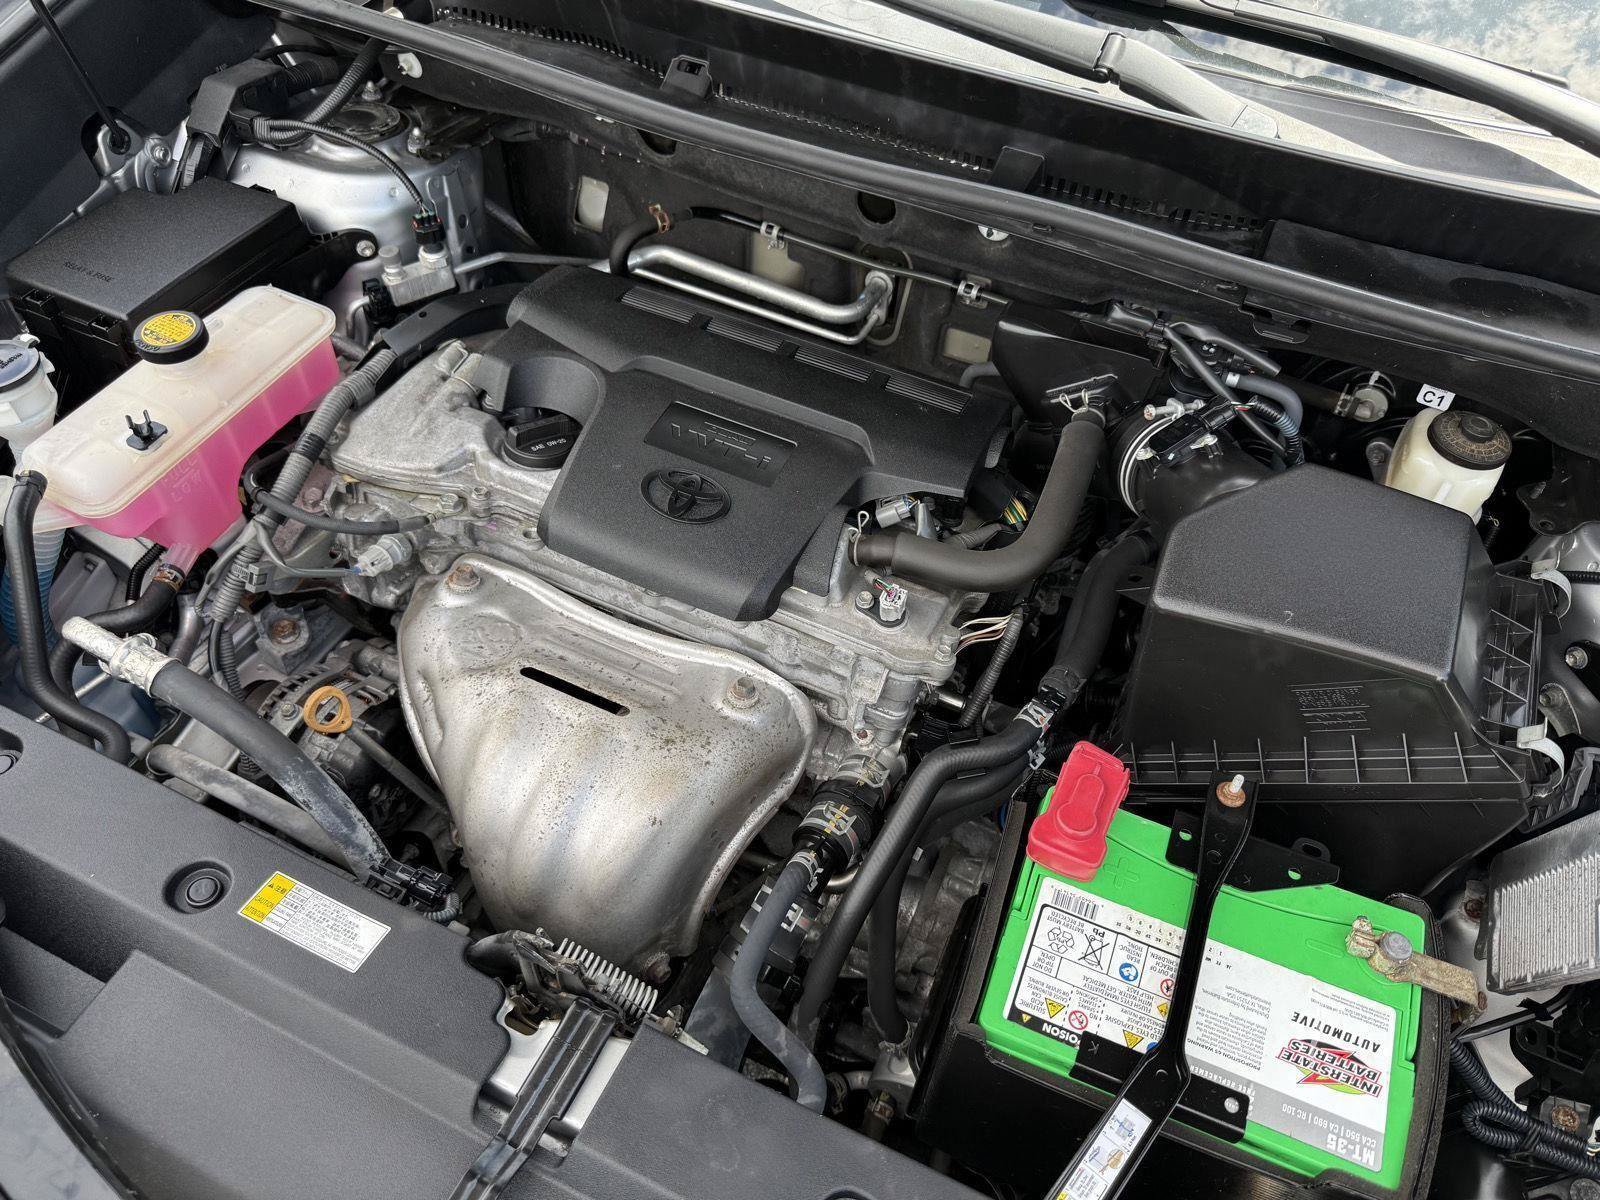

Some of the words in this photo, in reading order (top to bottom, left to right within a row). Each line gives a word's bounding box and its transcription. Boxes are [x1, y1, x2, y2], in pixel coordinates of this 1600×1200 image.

[1423, 390, 1445, 407] C1
[530, 443, 546, 452] SAE
[546, 438, 567, 446] 0W-20
[253, 894, 275, 908] CAUTION
[244, 904, 266, 918] ATTENTION
[1046, 914, 1062, 925] MUST
[1062, 921, 1084, 934] BATTERY
[1091, 927, 1105, 937] Pb
[1125, 953, 1140, 964] READ
[1032, 961, 1043, 969] NOT
[1154, 960, 1171, 970] REACH
[1157, 967, 1168, 976] OUT
[1081, 974, 1106, 989] MEDICAL
[1030, 990, 1041, 998] CAN
[1082, 981, 1120, 1001] IMMEDIATELY
[1105, 984, 1116, 993] GET
[1029, 996, 1044, 1006] ACID
[1075, 989, 1098, 1002] SMOKING
[1119, 996, 1133, 1006] EYES
[1139, 990, 1154, 1000] HELP
[1076, 1001, 1096, 1012] SPARKS
[1078, 996, 1097, 1007] FLAMES
[1136, 996, 1152, 1007] WITH
[1133, 1002, 1151, 1014] FLUSH
[1104, 1014, 1134, 1030] EXPLOSIVE
[1126, 1016, 1142, 1026] CAUSE
[1142, 1022, 1153, 1031] CAN
[1149, 1032, 1162, 1042] ELD
[1290, 1009, 1380, 1055] AUTOMOTIVE
[1186, 1037, 1213, 1051] WARNING
[1222, 1052, 1260, 1070] PROPOSITION
[1290, 1039, 1377, 1082] BATTERIES
[1189, 1064, 1235, 1088] REPLACEMEN
[1280, 1048, 1379, 1096] INTERSTATE
[1281, 1102, 1295, 1116] 100
[1295, 1108, 1306, 1120] RC
[1313, 1115, 1327, 1129] 690
[1328, 1121, 1338, 1133] CA
[1345, 1128, 1359, 1142] 550
[1361, 1134, 1376, 1148] CCA
[1325, 1132, 1374, 1166] MT-35
